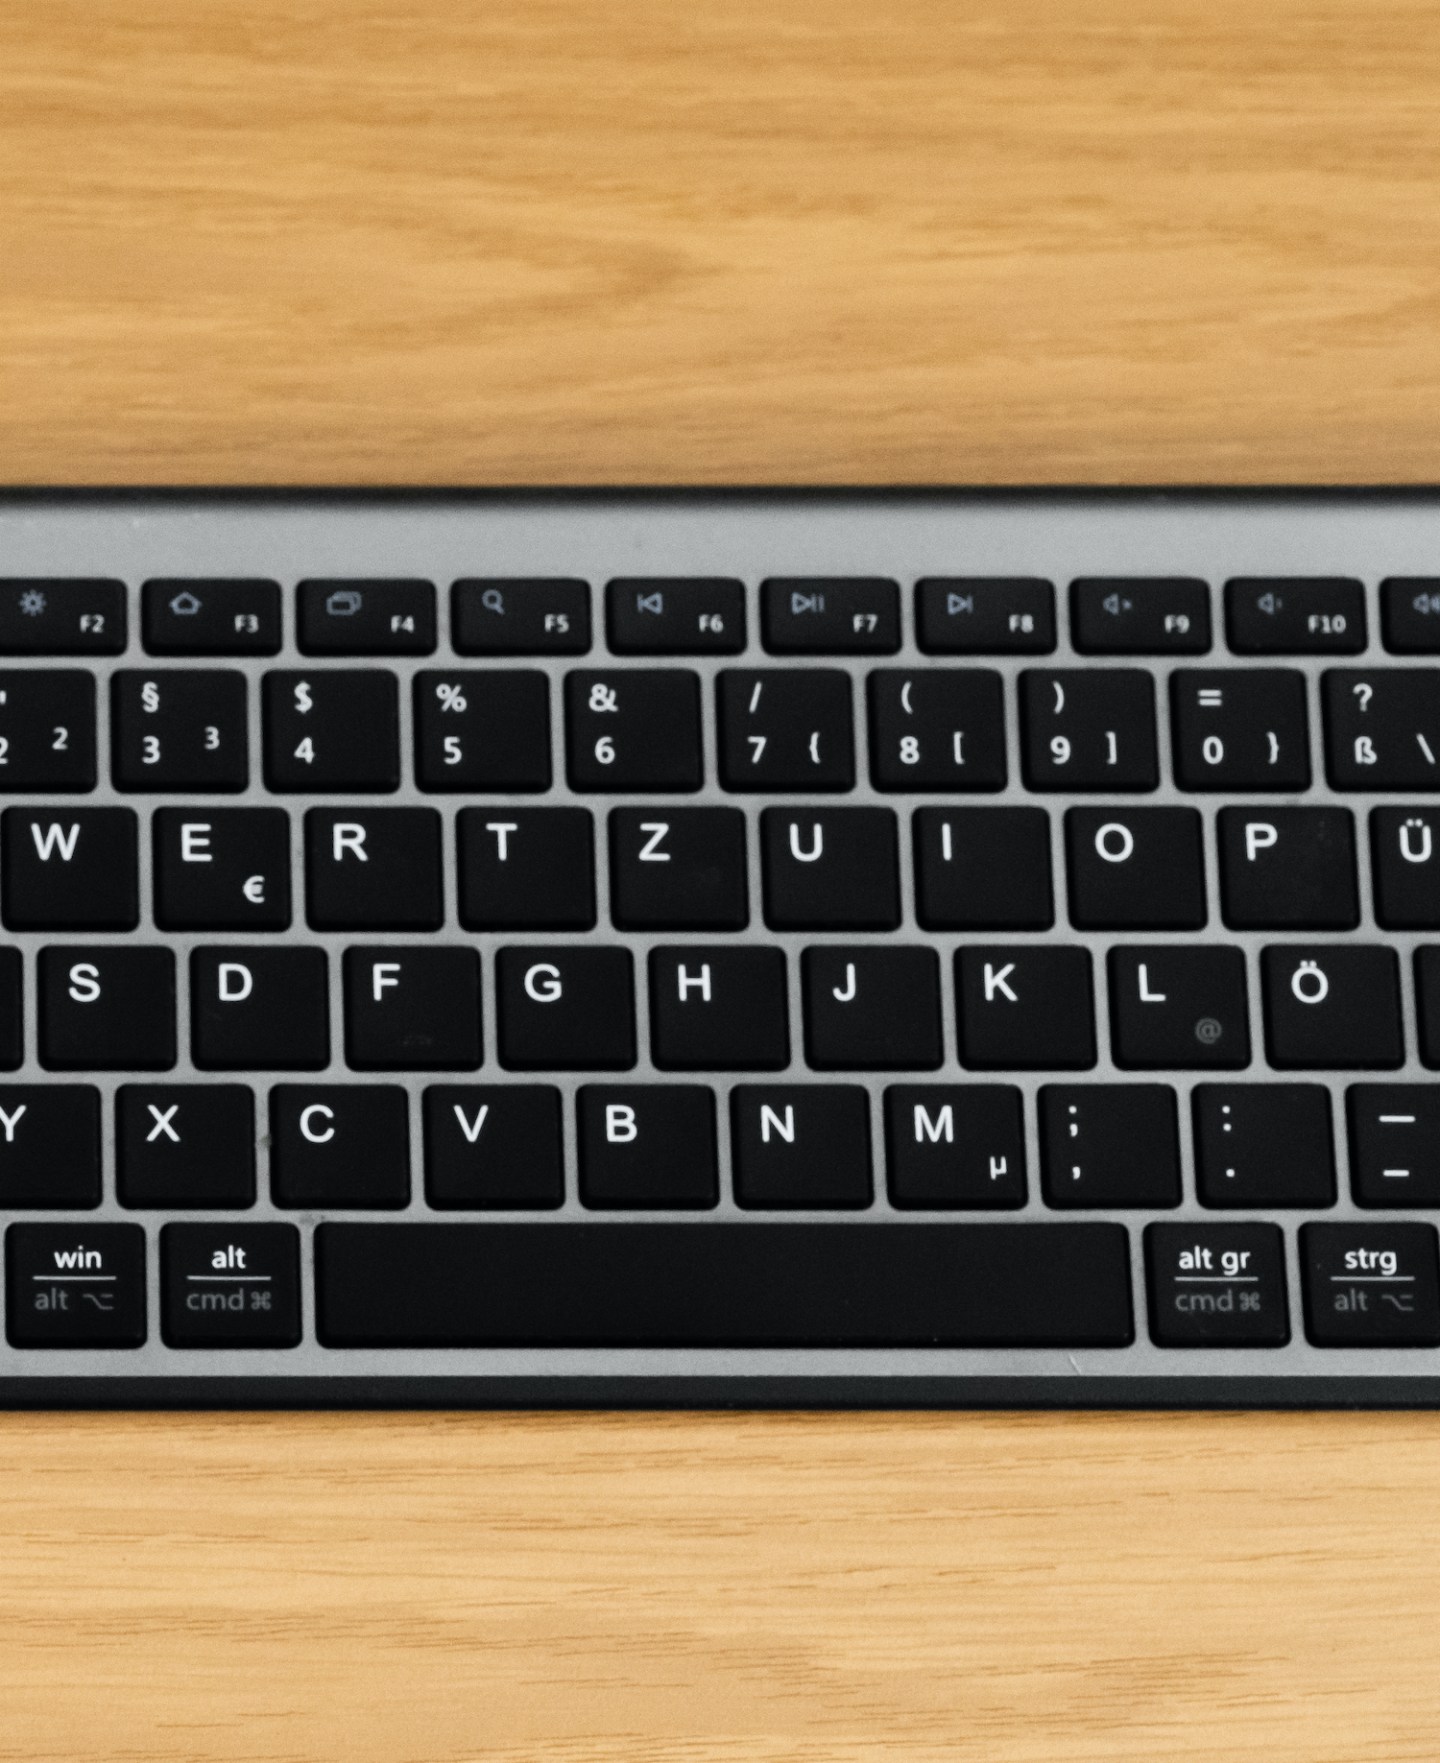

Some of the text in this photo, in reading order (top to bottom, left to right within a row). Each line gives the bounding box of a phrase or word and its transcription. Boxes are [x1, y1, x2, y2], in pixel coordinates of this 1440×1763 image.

[80, 615, 104, 632] F2
[235, 615, 258, 632] F3
[391, 616, 414, 631] F4
[545, 614, 569, 632] F5
[699, 615, 723, 632] F6
[853, 614, 877, 632] F7
[1009, 615, 1033, 632] F8
[1165, 615, 1189, 633] F9
[1308, 615, 1346, 633] F10
[142, 682, 159, 712] §
[294, 682, 312, 713] $
[436, 684, 467, 712] %
[589, 684, 618, 712] &
[750, 682, 761, 712] /
[901, 682, 912, 713] (
[1054, 682, 1064, 713] )
[1198, 690, 1221, 706] =
[1354, 683, 1372, 711] ?
[53, 727, 68, 749] 2
[143, 727, 219, 763] 3 3
[294, 737, 314, 763] 4
[444, 737, 462, 764] 5
[595, 737, 615, 764] 6
[748, 732, 819, 763] 7 {
[900, 732, 963, 764] 8 [
[1051, 732, 1117, 764] 9 ]
[1203, 732, 1279, 764] 0 }
[1355, 734, 1435, 764] ß \
[31, 823, 80, 861] W
[182, 824, 212, 861] E
[333, 823, 367, 861] R
[486, 823, 517, 860] T
[639, 823, 670, 861] Z
[790, 824, 822, 861] U
[942, 823, 951, 860] I
[1095, 823, 1133, 862] O
[1246, 823, 1277, 861] P
[1399, 819, 1431, 862] Ü
[243, 876, 264, 903] €
[69, 964, 100, 1002] S
[219, 963, 252, 1001] D
[373, 964, 400, 1001] F
[525, 964, 562, 1002] G
[678, 964, 711, 1001] H
[833, 963, 856, 1001] J
[984, 964, 1017, 1001] K
[1139, 964, 1166, 1001] L
[1291, 960, 1328, 1003] Ö
[1195, 1018, 1222, 1044] @
[147, 1105, 180, 1142] X
[300, 1105, 334, 1142] C
[454, 1105, 488, 1142] V
[606, 1105, 637, 1142] B
[761, 1105, 794, 1142] N
[914, 1105, 953, 1142] M
[1069, 1106, 1078, 1136] ;
[1222, 1106, 1231, 1131] :
[990, 1157, 1007, 1179] µ
[1073, 1167, 1080, 1179] ,
[1226, 1169, 1235, 1177] .
[54, 1245, 101, 1268] win
[212, 1245, 245, 1268] alt
[1179, 1246, 1250, 1276] alt gr
[1345, 1248, 1398, 1275] strg
[35, 1288, 68, 1310] alt
[187, 1288, 244, 1310] cmd
[1175, 1289, 1233, 1311] cmd
[1335, 1288, 1367, 1311] alt
